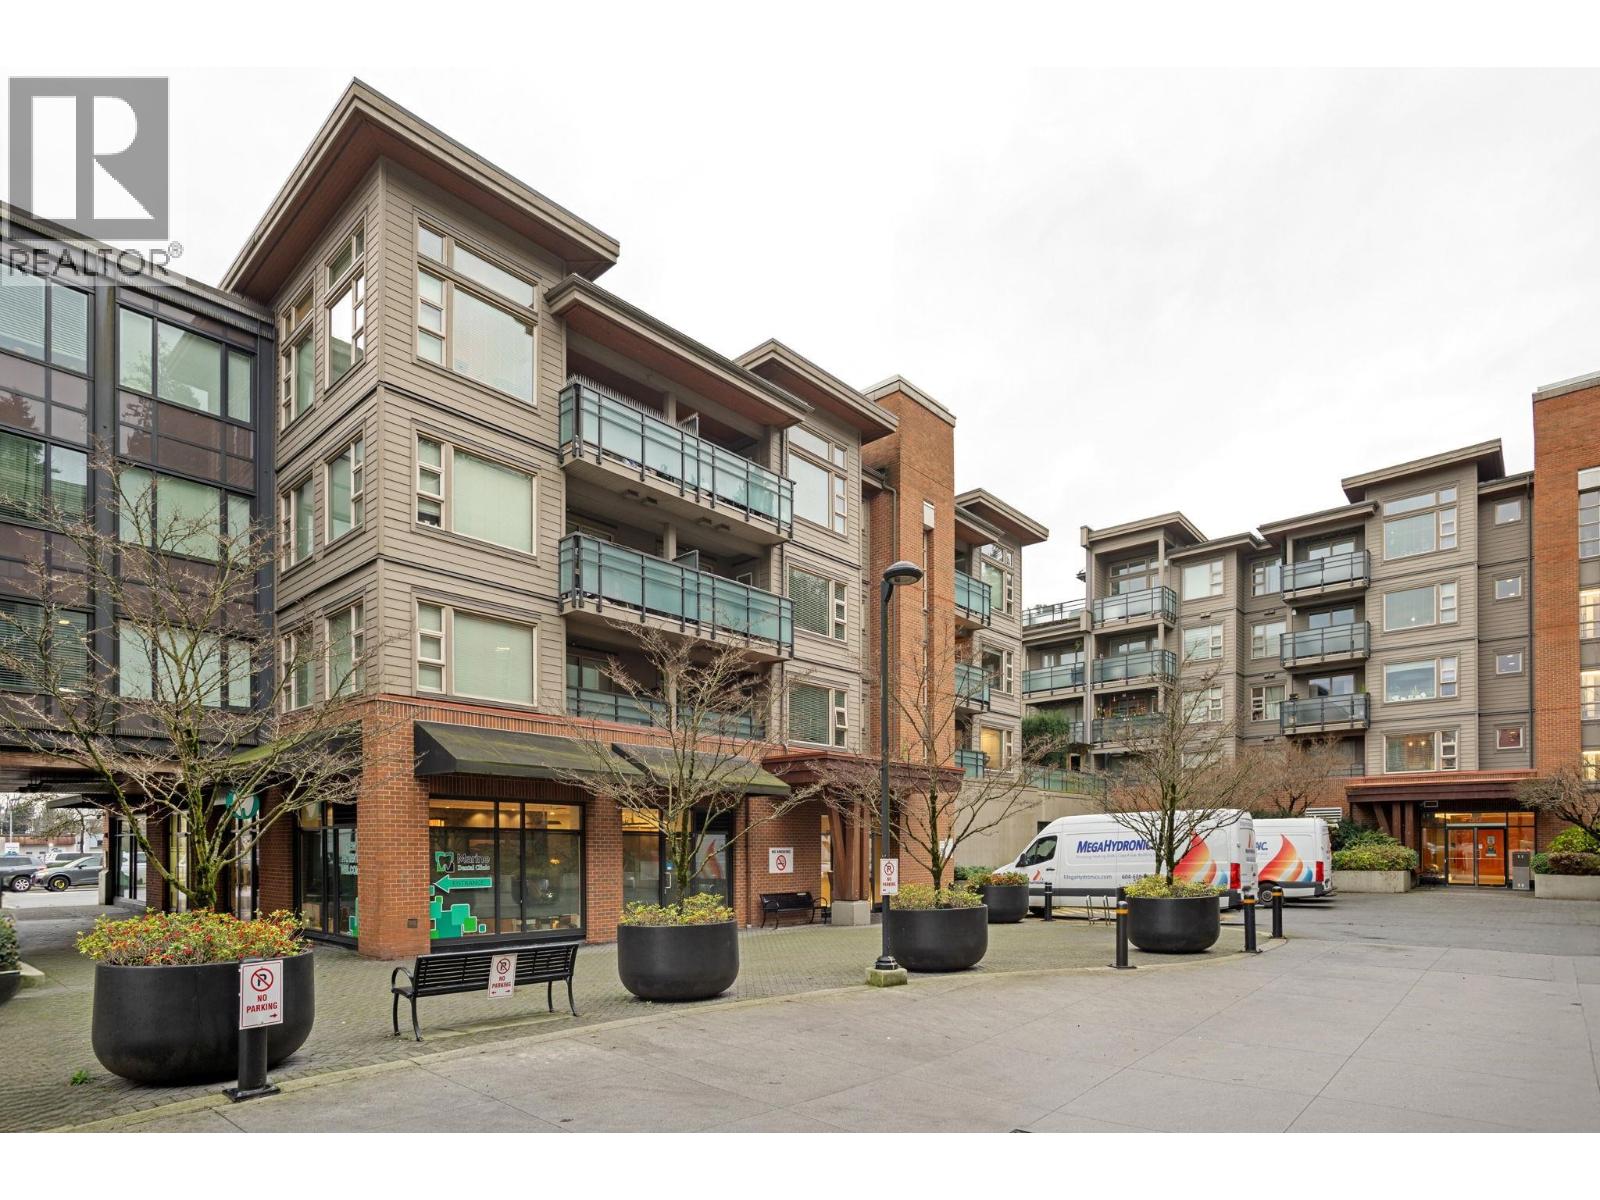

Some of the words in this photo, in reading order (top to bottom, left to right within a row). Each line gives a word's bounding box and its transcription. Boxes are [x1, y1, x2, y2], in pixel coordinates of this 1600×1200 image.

[456, 853, 491, 864] Marine
[491, 981, 512, 989] PARKING
[257, 994, 268, 1002] NO
[246, 1002, 278, 1013] PARKING
